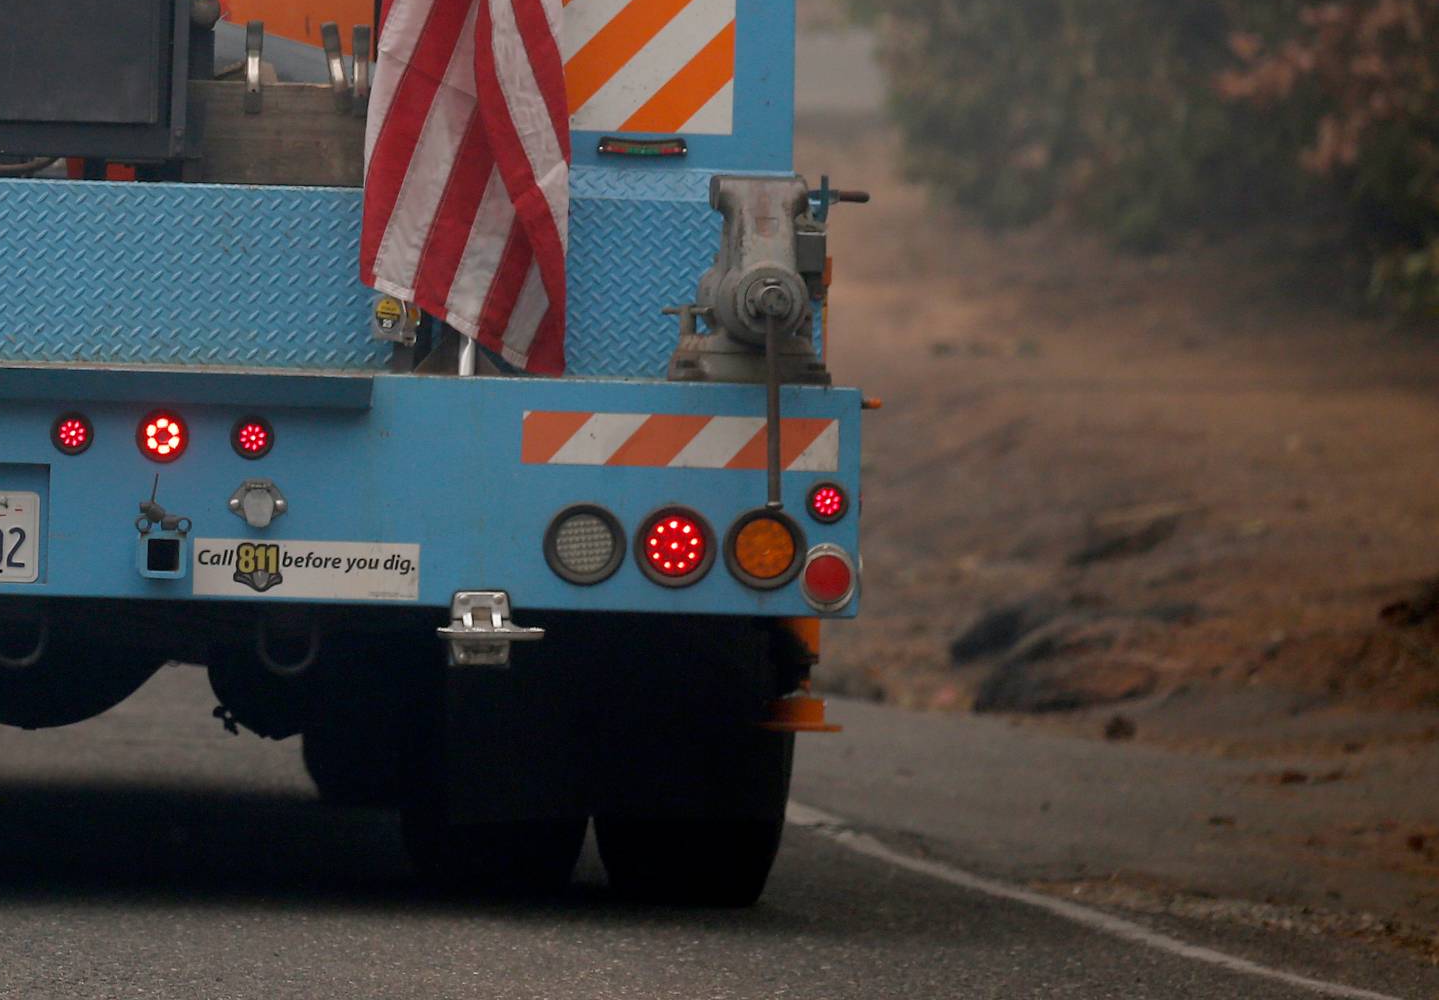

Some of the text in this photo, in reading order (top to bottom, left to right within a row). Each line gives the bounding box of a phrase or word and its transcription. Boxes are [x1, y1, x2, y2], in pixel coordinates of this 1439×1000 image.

[198, 543, 416, 575] Call 811 before you dig.
